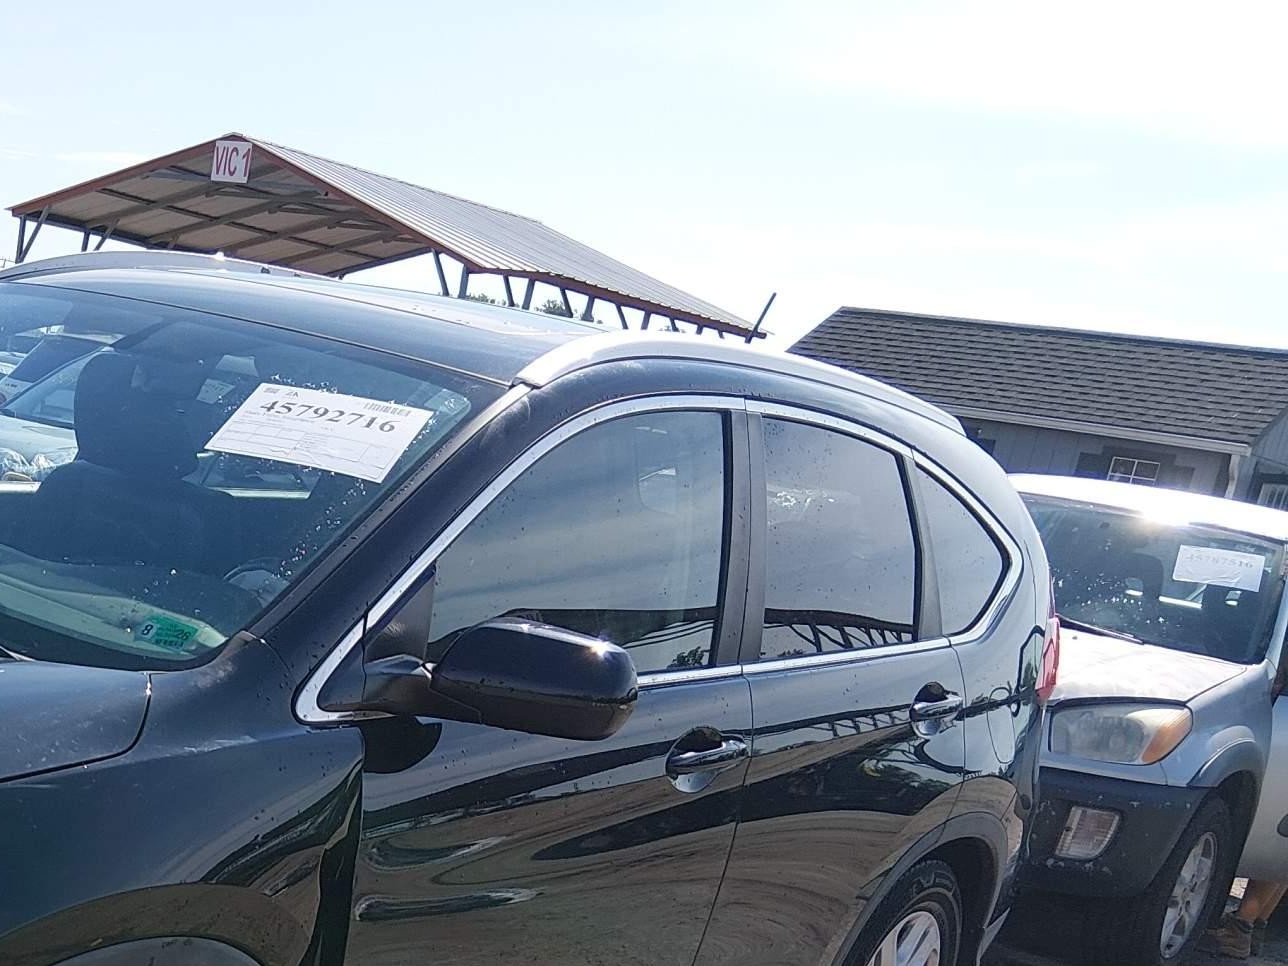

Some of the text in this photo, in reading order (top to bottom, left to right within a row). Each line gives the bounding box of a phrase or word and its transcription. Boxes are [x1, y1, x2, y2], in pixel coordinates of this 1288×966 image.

[215, 146, 251, 178] VIC 1
[260, 399, 401, 433] 45792716
[141, 624, 154, 636] 8
